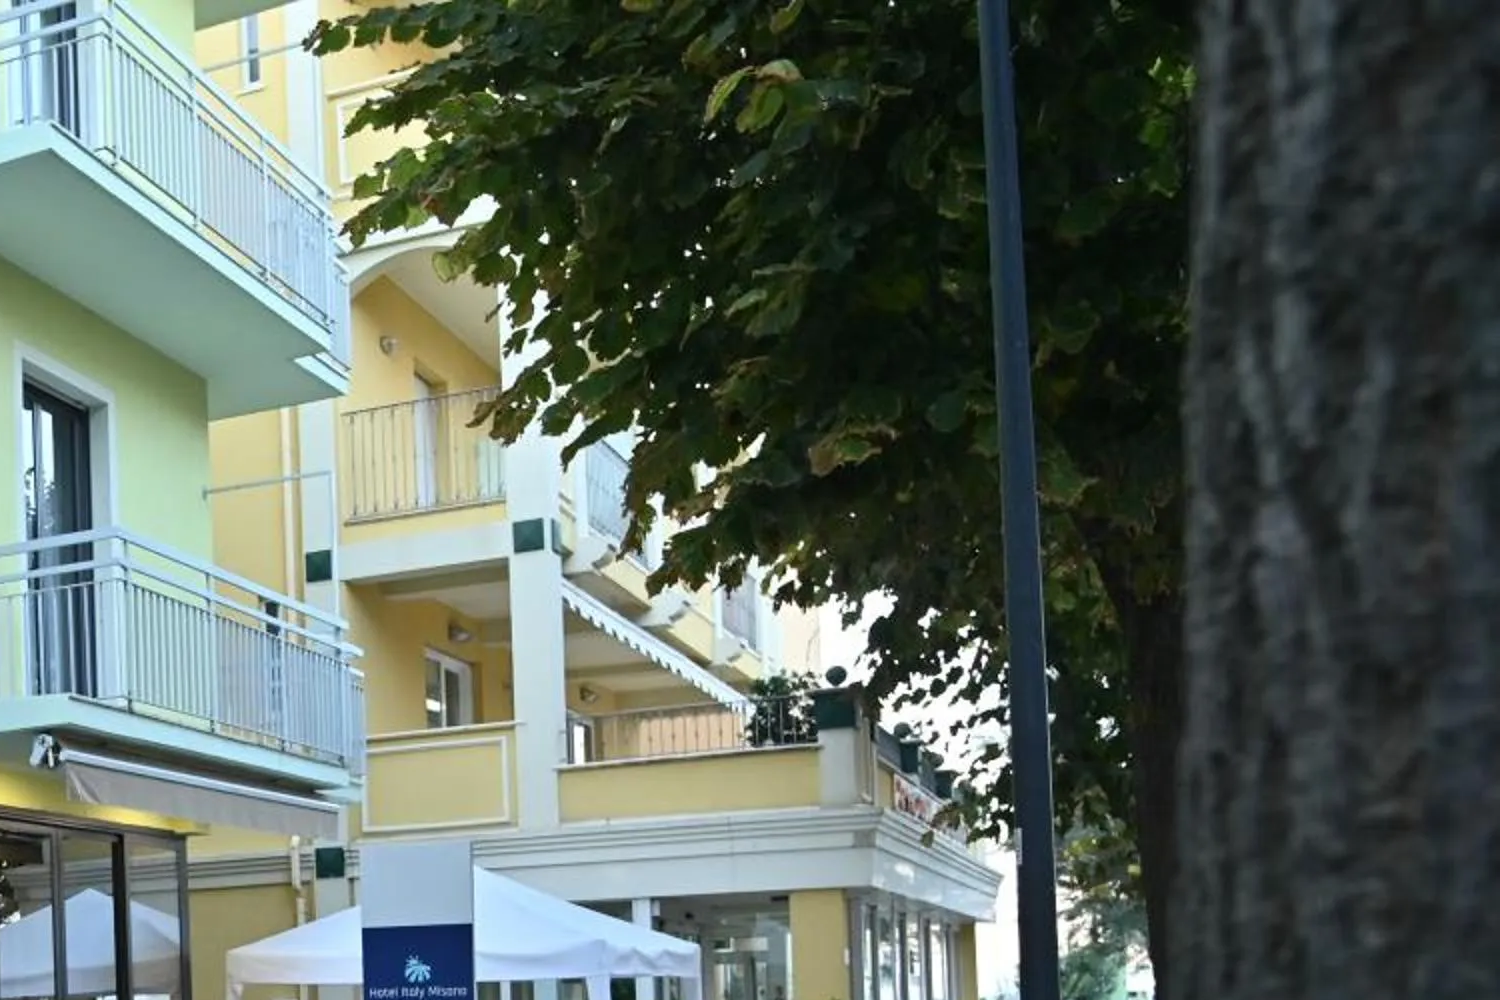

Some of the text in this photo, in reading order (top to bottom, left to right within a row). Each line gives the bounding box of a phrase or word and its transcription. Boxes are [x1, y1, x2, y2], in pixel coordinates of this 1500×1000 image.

[369, 985, 468, 1000] Hotel Italy Misano
